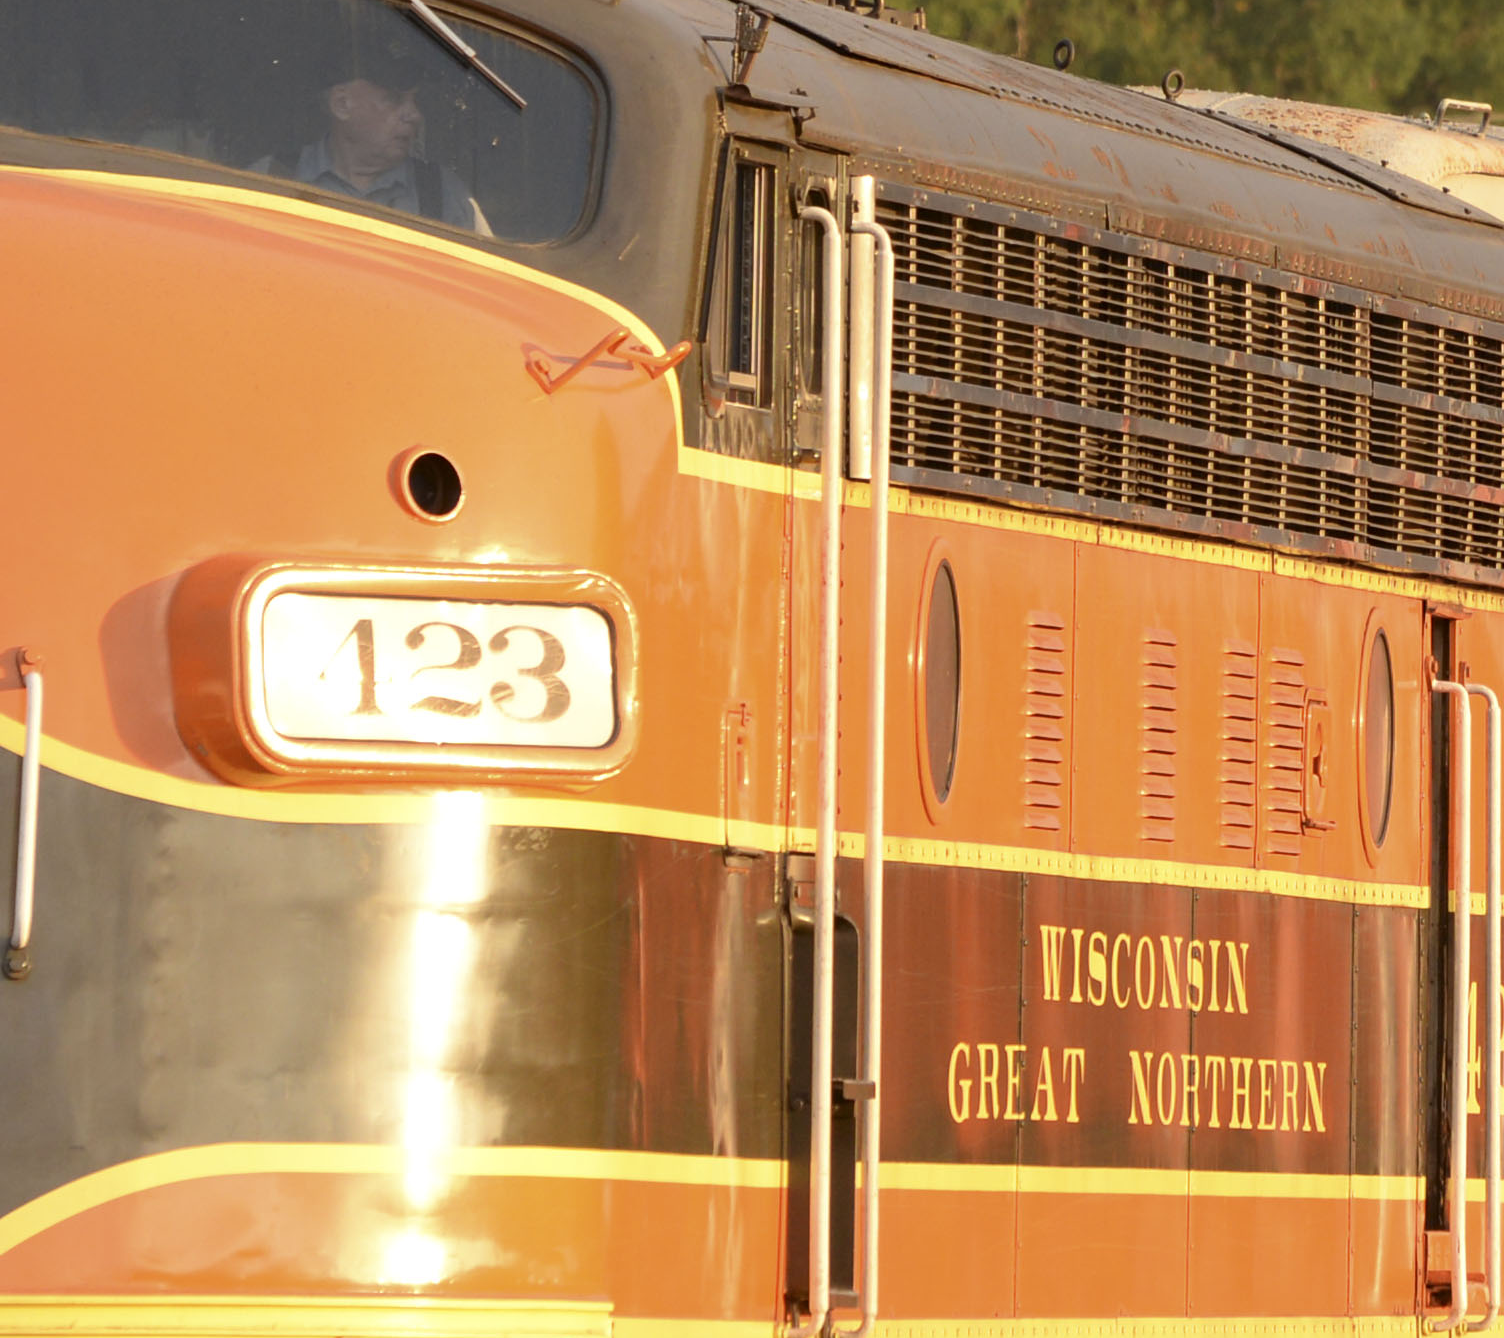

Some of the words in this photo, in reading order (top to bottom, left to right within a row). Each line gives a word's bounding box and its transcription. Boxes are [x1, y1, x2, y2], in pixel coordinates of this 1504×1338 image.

[319, 618, 572, 724] 423
[1039, 924, 1250, 1016] WISCONSIN
[947, 1042, 1086, 1124] GREAT
[1128, 1051, 1327, 1134] NORTHERN
